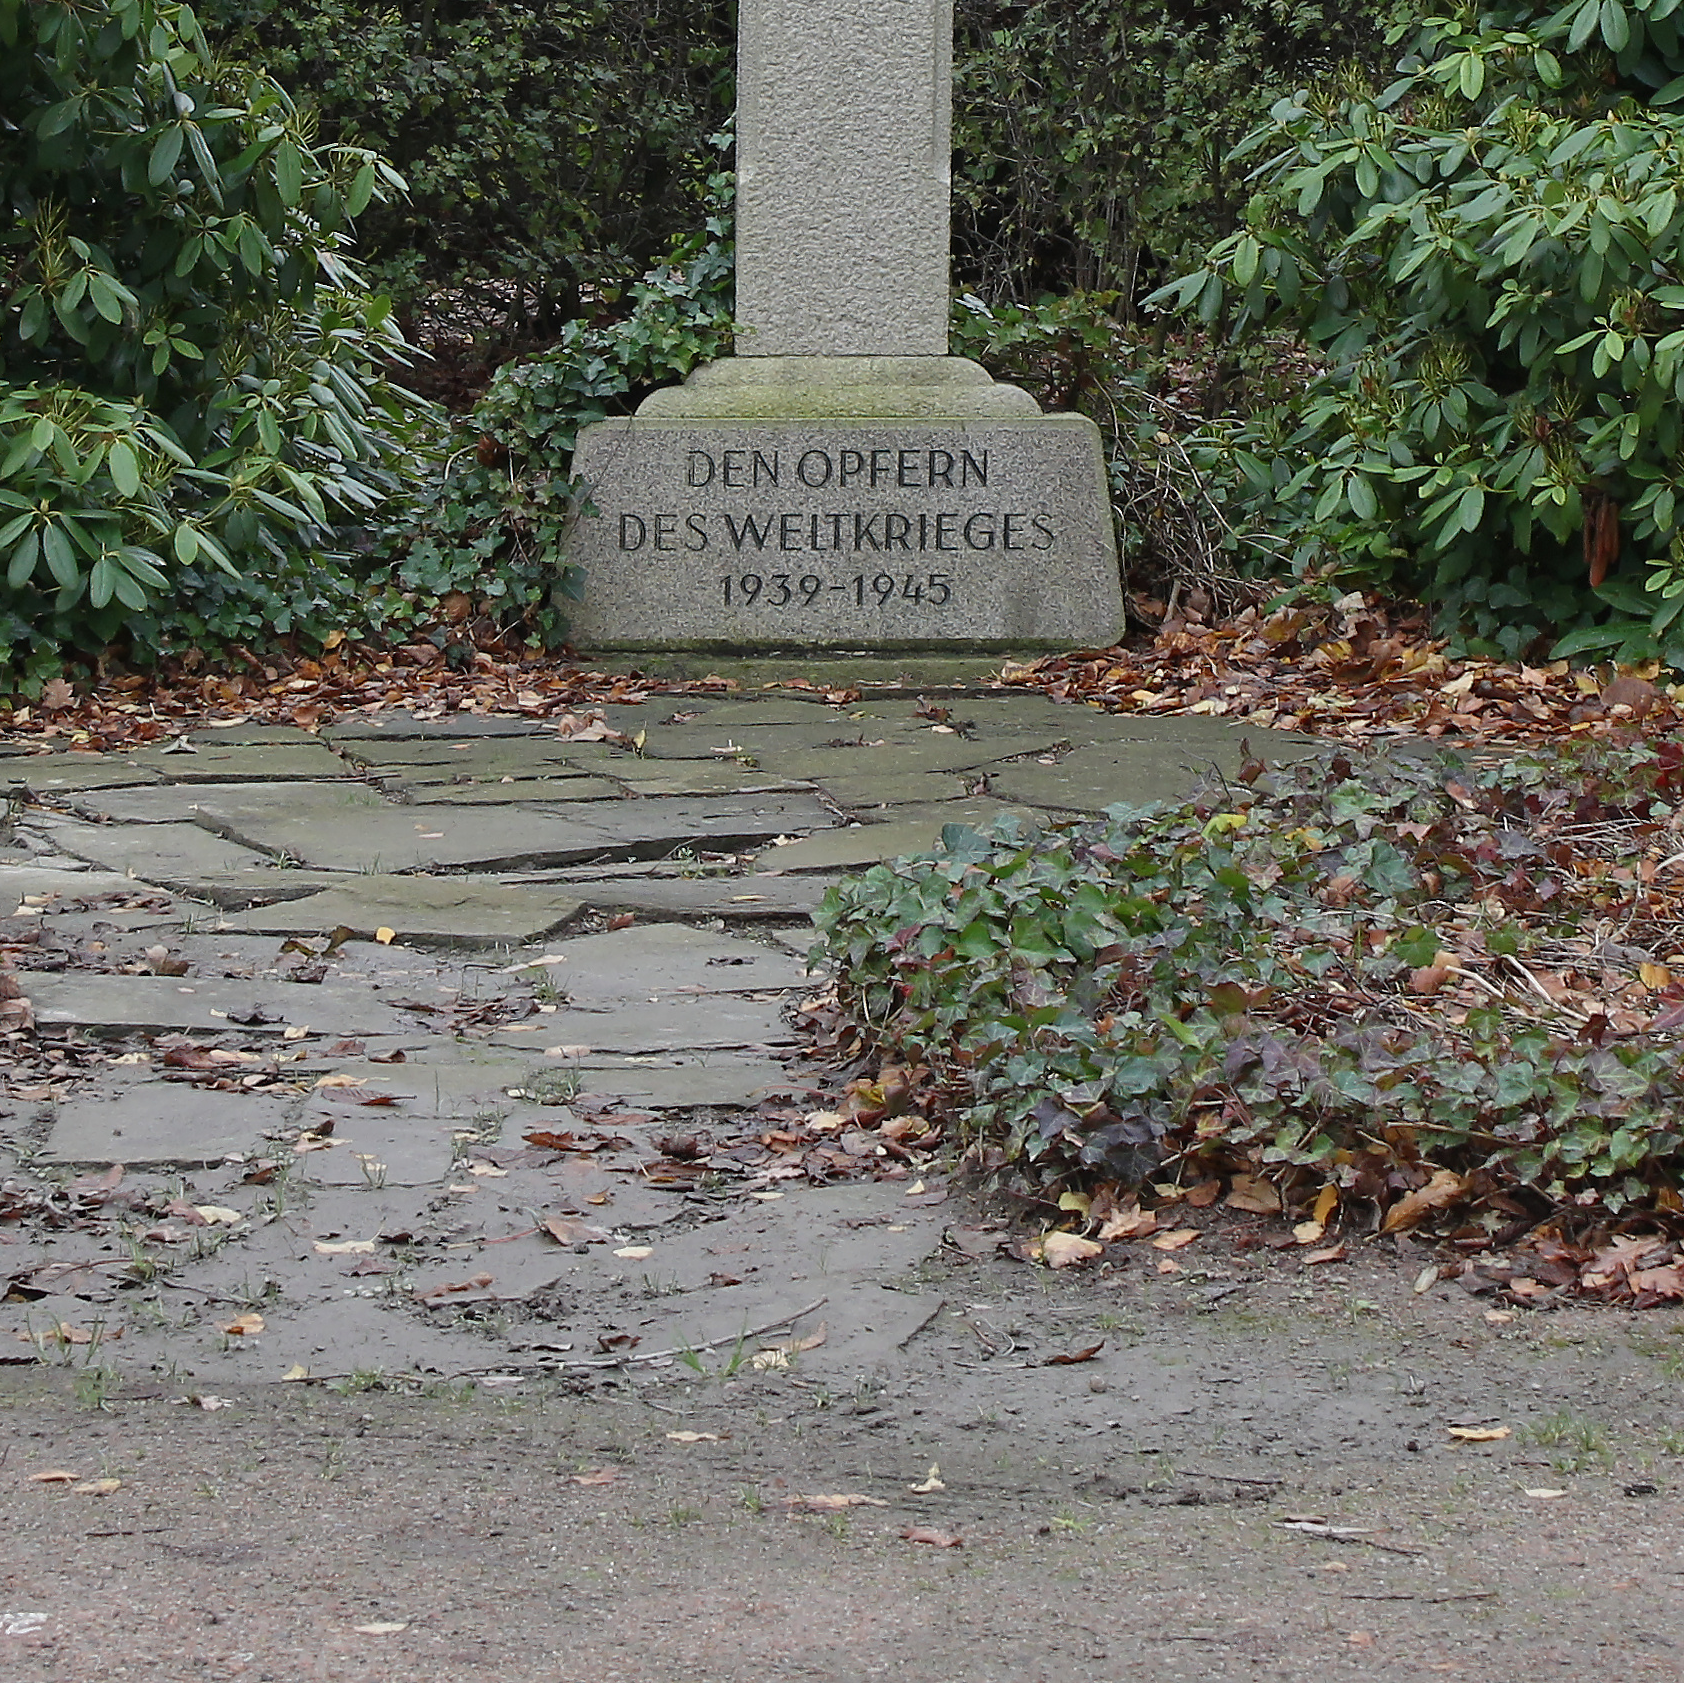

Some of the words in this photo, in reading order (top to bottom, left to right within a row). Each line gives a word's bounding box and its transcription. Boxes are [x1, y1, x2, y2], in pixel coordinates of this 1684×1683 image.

[687, 449, 780, 488] DEN
[797, 449, 989, 488] OPFERN
[618, 512, 709, 552] DES
[724, 512, 1057, 552] WELTKRIEGES
[720, 572, 953, 607] 1939-1945
